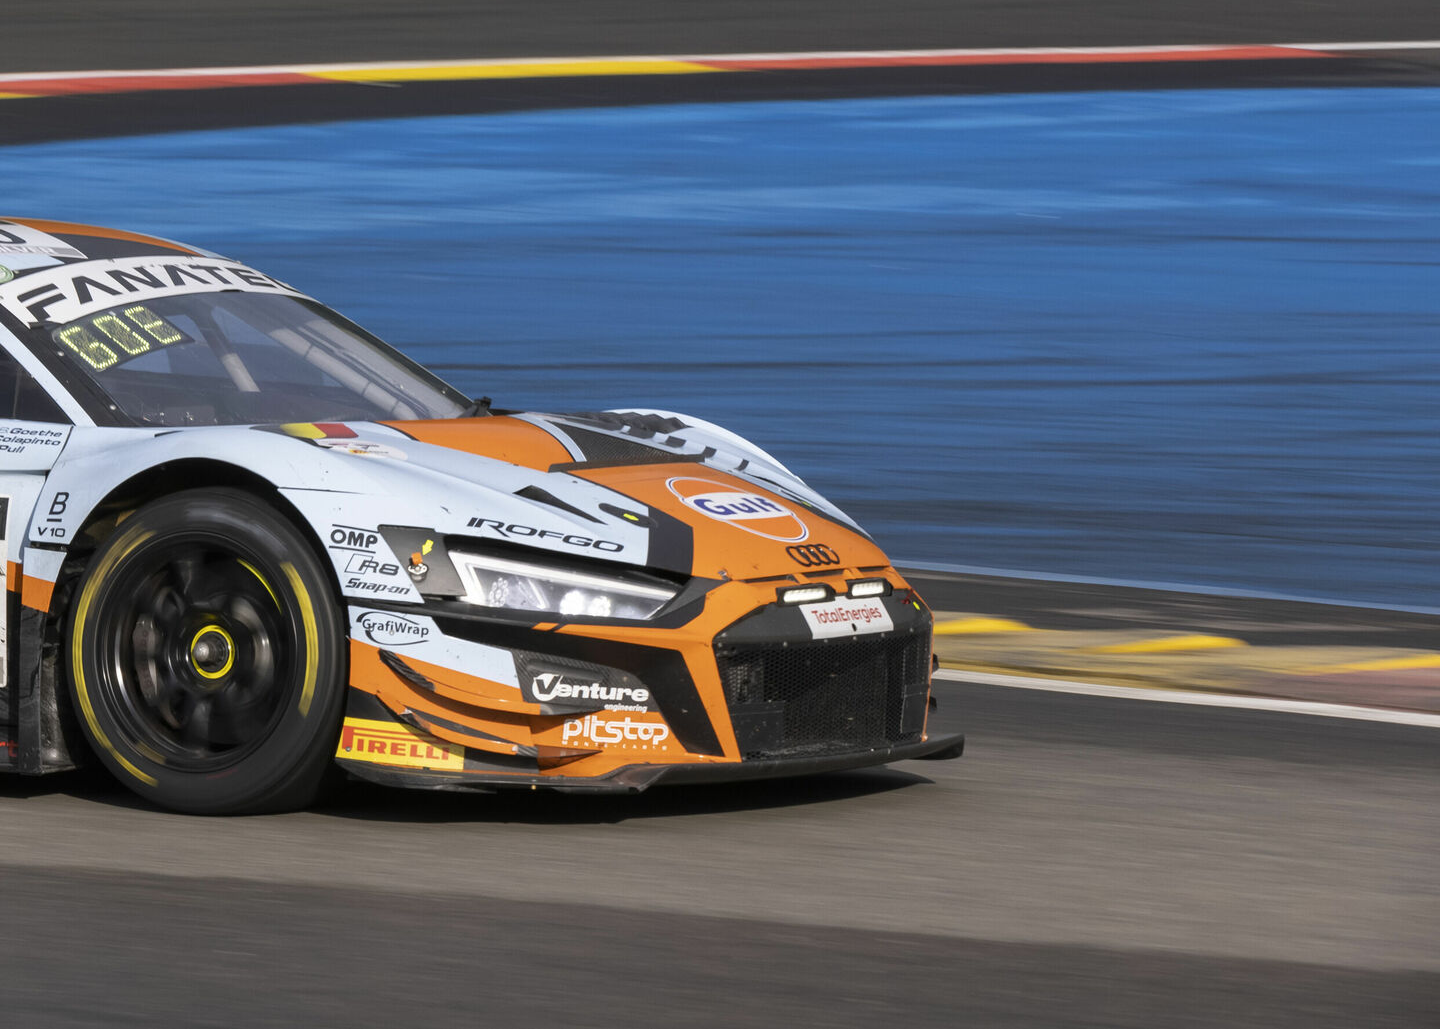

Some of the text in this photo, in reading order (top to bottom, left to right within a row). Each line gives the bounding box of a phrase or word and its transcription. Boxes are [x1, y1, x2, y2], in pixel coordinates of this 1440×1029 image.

[693, 497, 785, 516] Gulf
[330, 529, 378, 549] OMP
[358, 560, 400, 576] R8
[345, 577, 410, 595] Snap-on
[811, 605, 882, 625] TotalEnergies
[362, 618, 429, 638] GrafiWrap
[532, 673, 650, 702] Venture
[604, 703, 648, 714] engineering
[562, 715, 669, 746] pitstop
[341, 725, 451, 761] PIRELLI
